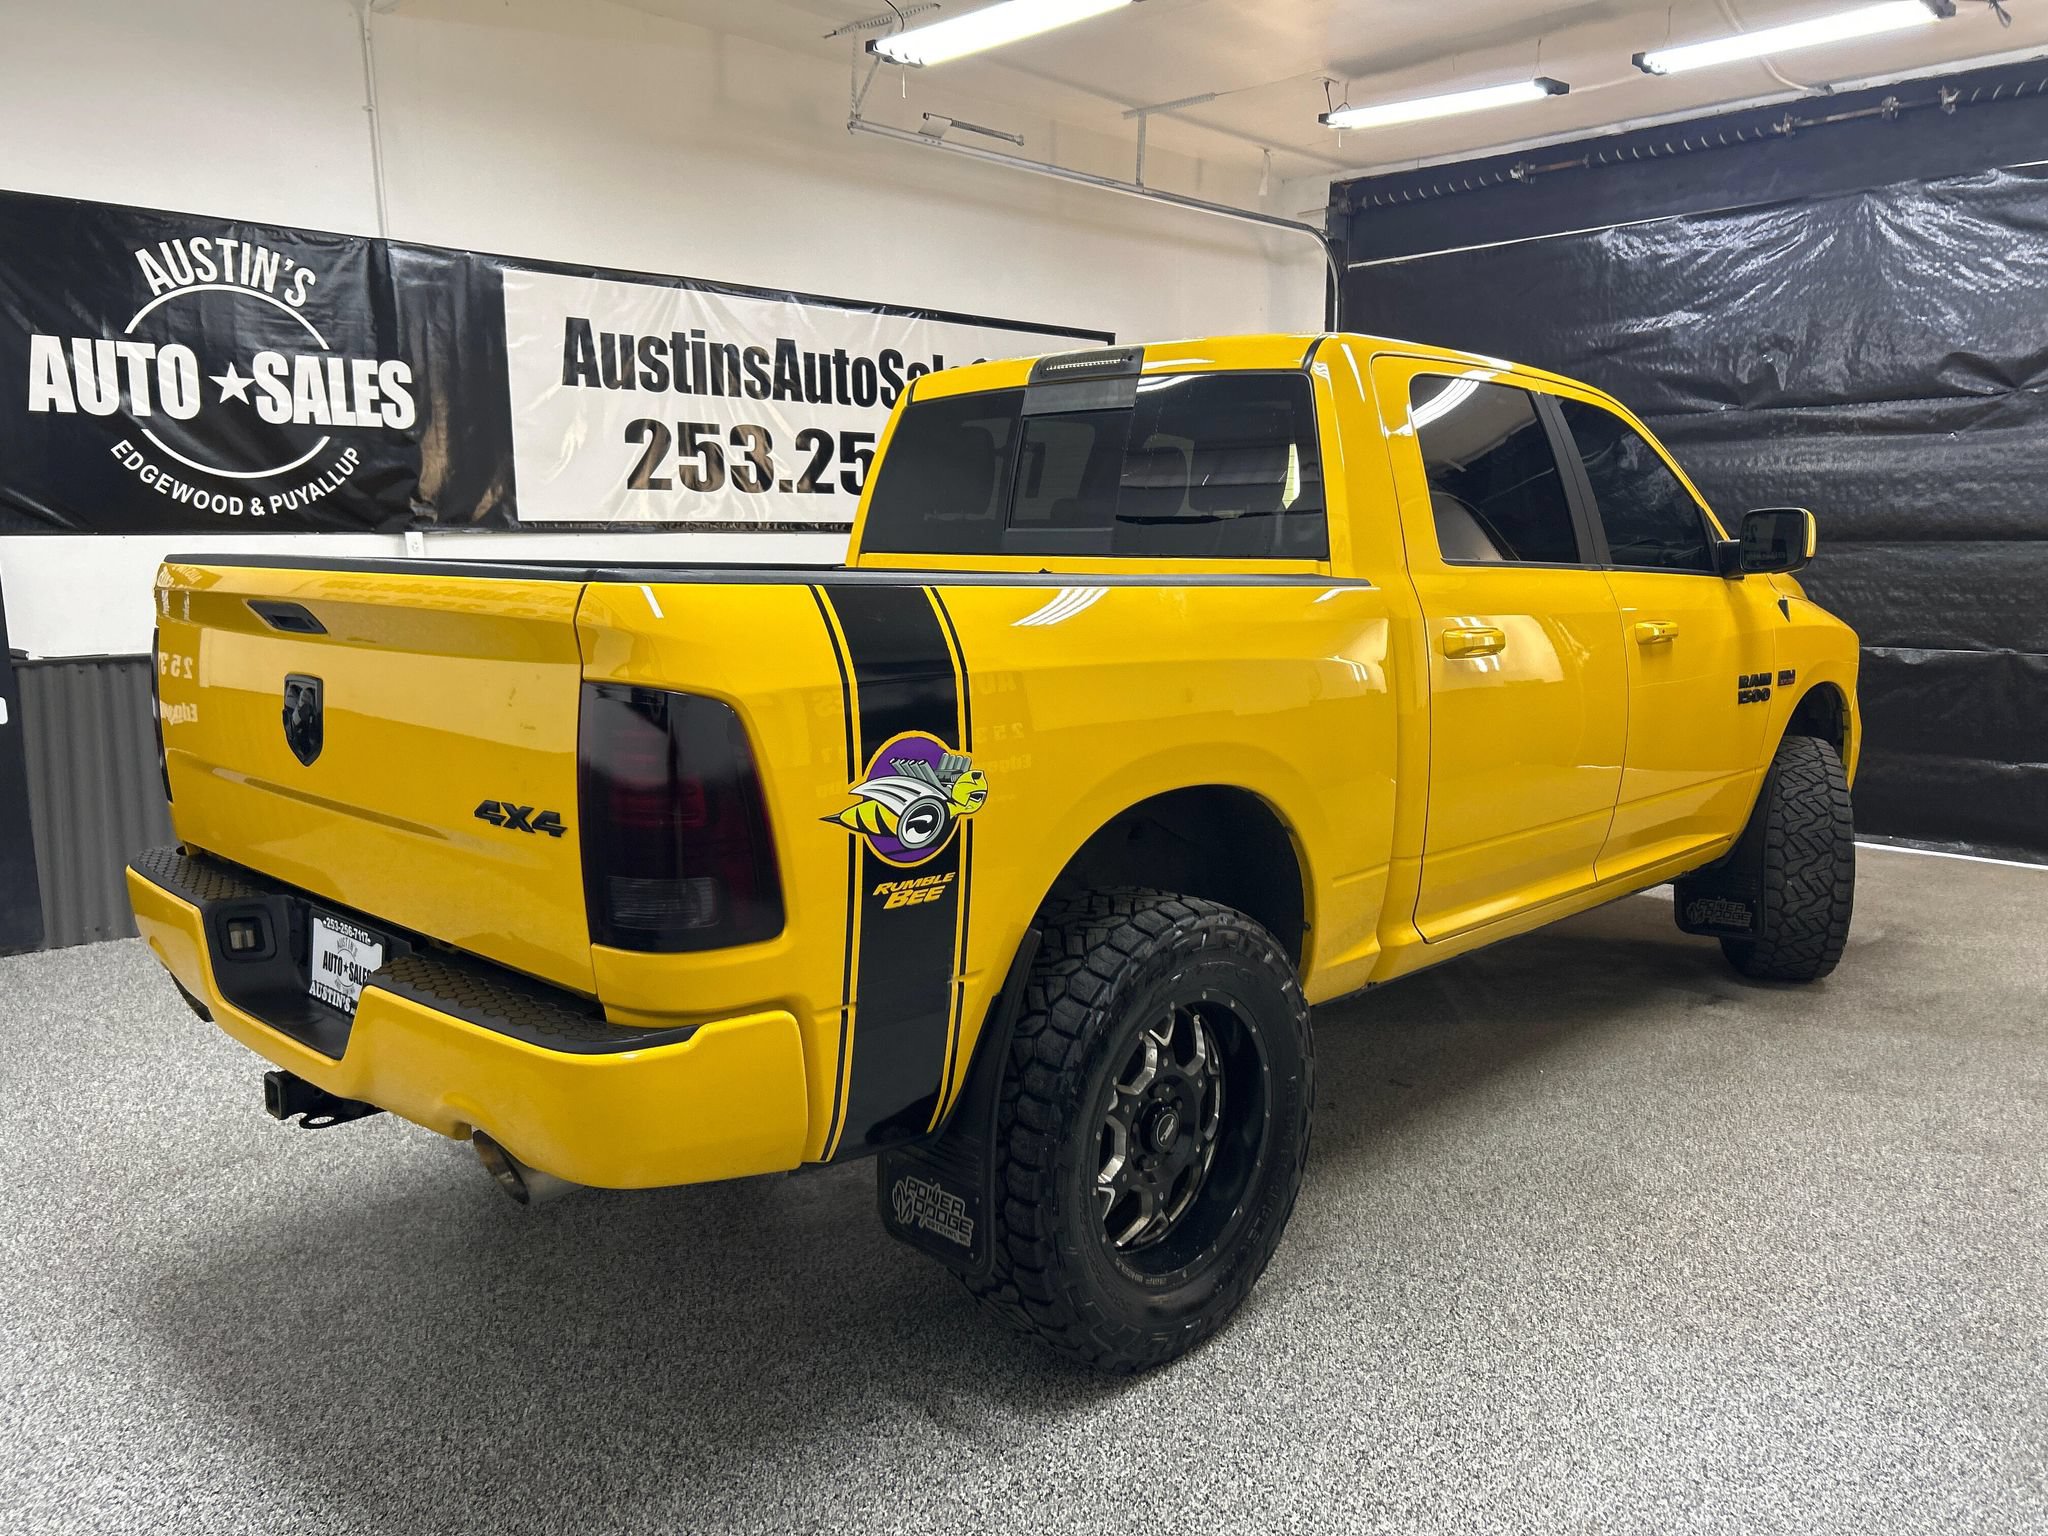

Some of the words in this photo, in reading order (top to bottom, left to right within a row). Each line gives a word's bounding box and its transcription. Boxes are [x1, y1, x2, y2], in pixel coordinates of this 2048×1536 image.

[134, 237, 316, 307] AUSTIN'S
[28, 334, 201, 420] AUTO
[252, 351, 415, 429] SALES
[110, 439, 244, 516] EDGEWOOD
[250, 497, 266, 516] &
[269, 447, 361, 514] PUYALLUP
[872, 871, 956, 896] RUMBLE
[883, 885, 946, 910] BEE
[325, 917, 368, 943] 253-256-7117
[322, 950, 343, 977] AUTO
[308, 980, 351, 1012] AUSTIN'S
